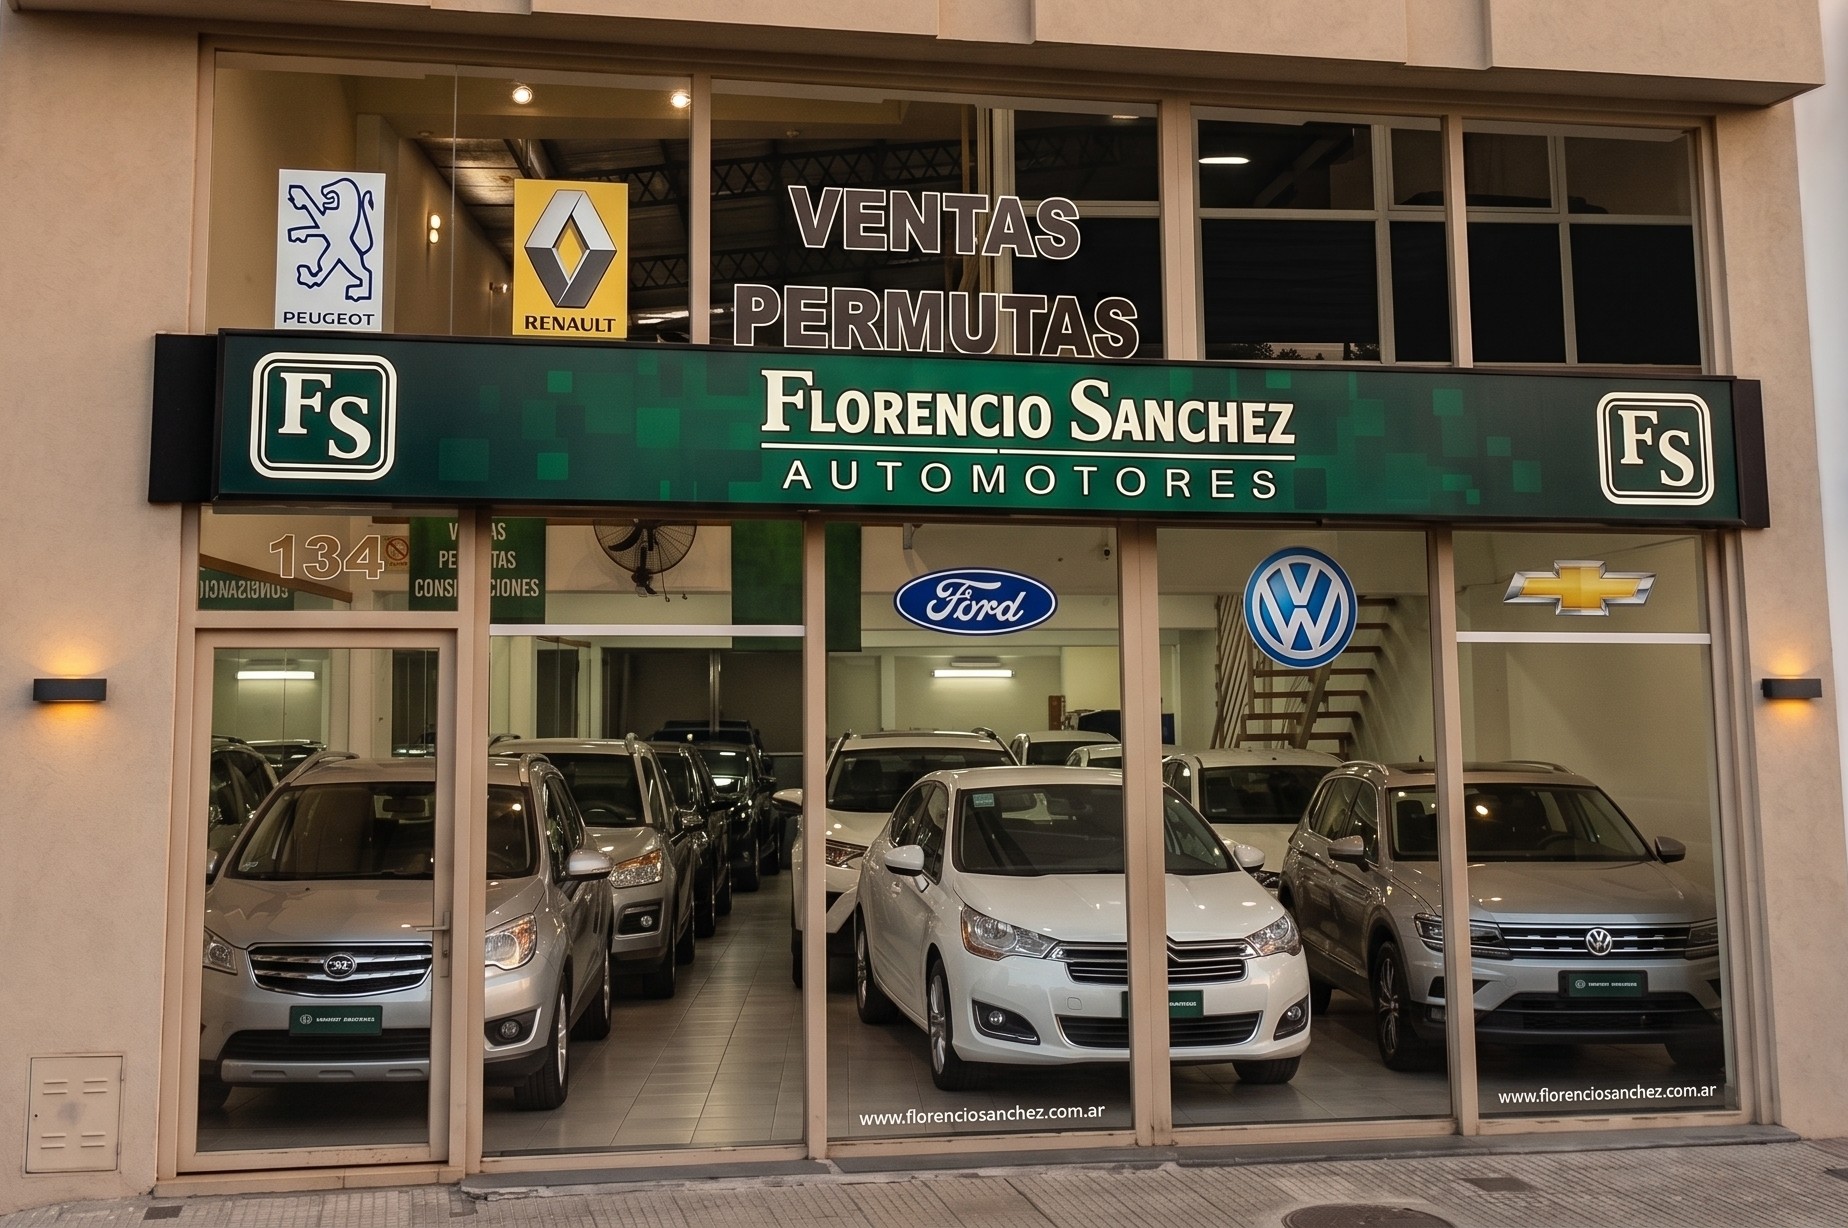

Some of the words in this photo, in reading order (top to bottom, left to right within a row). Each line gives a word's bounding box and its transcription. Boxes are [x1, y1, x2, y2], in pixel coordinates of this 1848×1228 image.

[787, 184, 1081, 260] VENTAS
[283, 311, 375, 326] PEUGEOT
[524, 315, 616, 333] RENAULT
[733, 283, 1140, 359] PERMUTAS
[278, 372, 371, 459] FS
[761, 369, 1052, 439] FLORENCIO
[1070, 378, 1295, 445] SANCHEZ
[1617, 409, 1695, 487] FS
[782, 460, 1277, 499] AUTOMOTORES
[269, 533, 385, 580] 134
[438, 550, 517, 569] PETAS
[926, 578, 1027, 622] Ford
[859, 1104, 1106, 1126] www.florenciosanchez.com.ar
